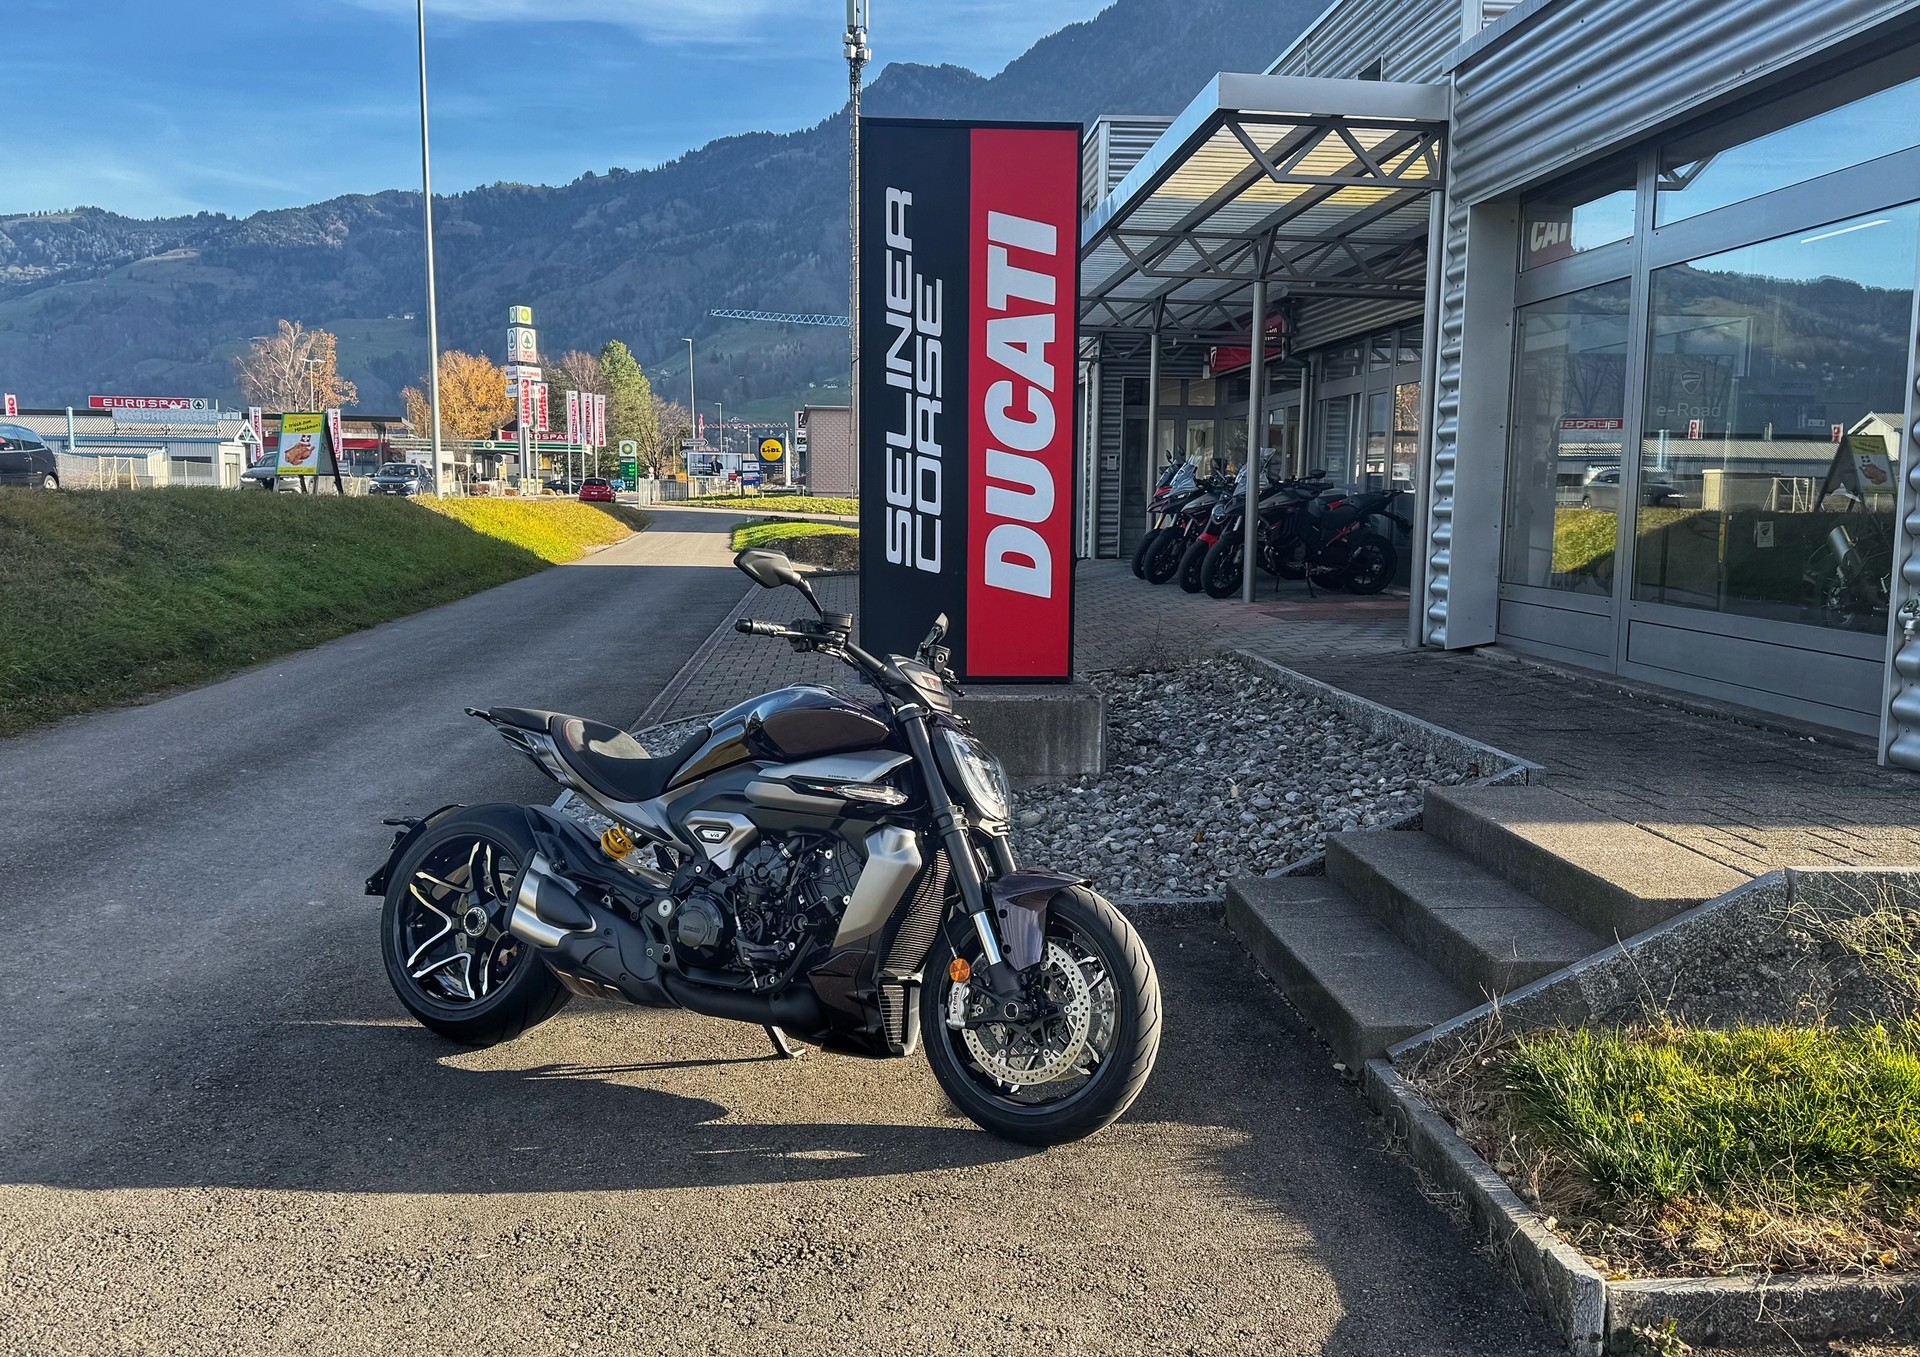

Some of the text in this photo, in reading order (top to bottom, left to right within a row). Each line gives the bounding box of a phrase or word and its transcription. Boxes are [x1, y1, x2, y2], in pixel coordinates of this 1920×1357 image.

[102, 398, 190, 409] EUROSPAR
[886, 186, 913, 568] SELINER
[916, 271, 943, 574] CORSE
[984, 210, 1058, 599] DUCATI
[1656, 402, 1721, 418] e-Road
[952, 986, 960, 1015] brembo
